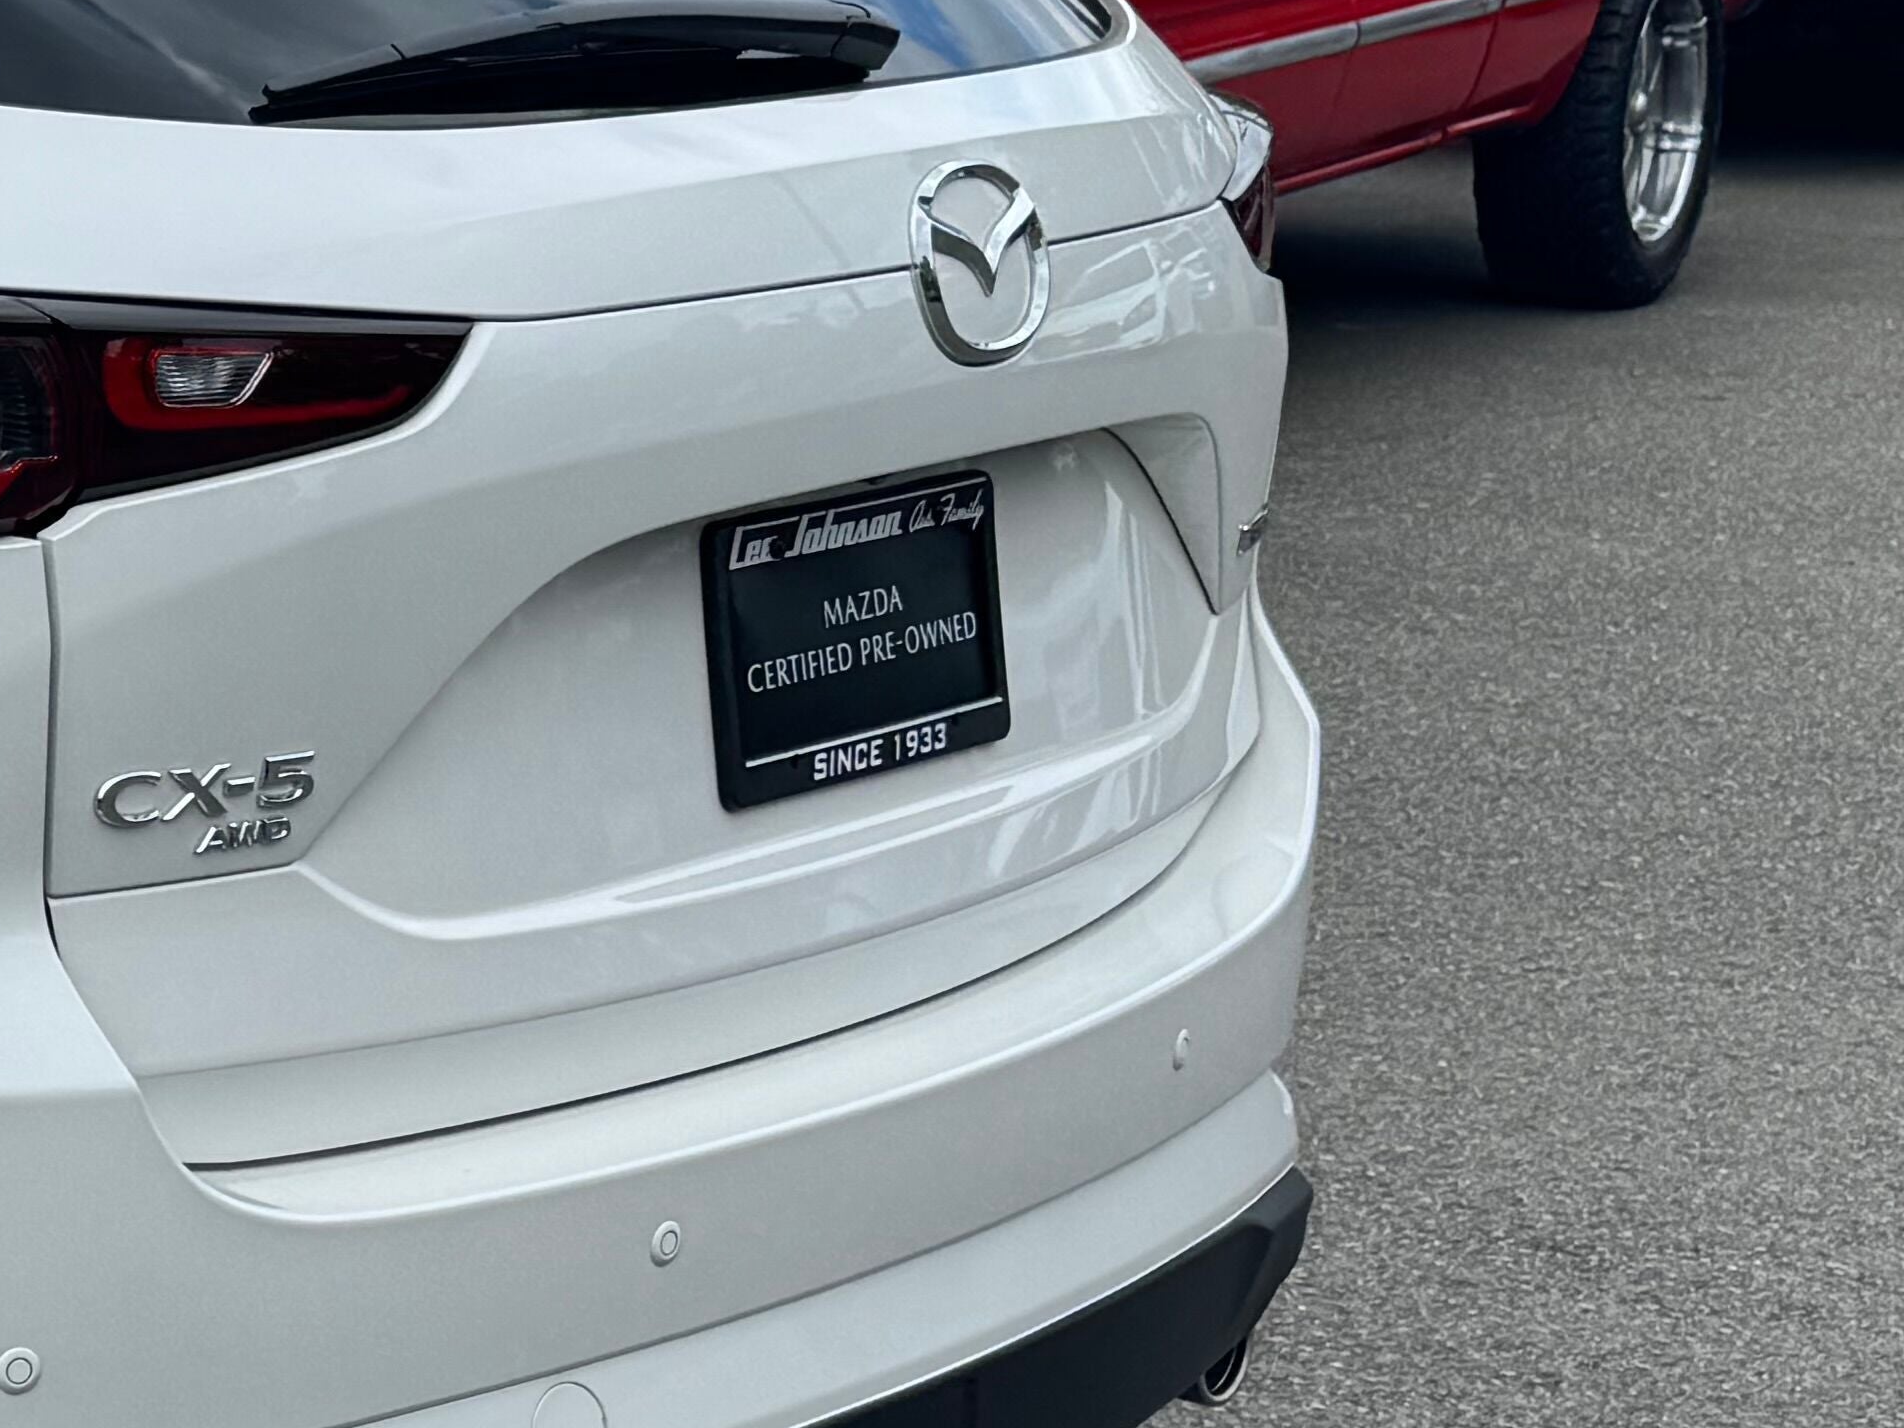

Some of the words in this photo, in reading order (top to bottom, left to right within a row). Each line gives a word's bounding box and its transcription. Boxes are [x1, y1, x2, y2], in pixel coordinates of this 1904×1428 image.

[784, 508, 903, 558] Johnson
[823, 585, 903, 628] MAZDA
[747, 642, 853, 693] CERTIFIED
[860, 611, 977, 666] PRE-OWNED
[813, 737, 884, 781] SINCE
[894, 723, 947, 762] 1933
[94, 750, 315, 829] CX-5
[194, 816, 291, 855] AWD
